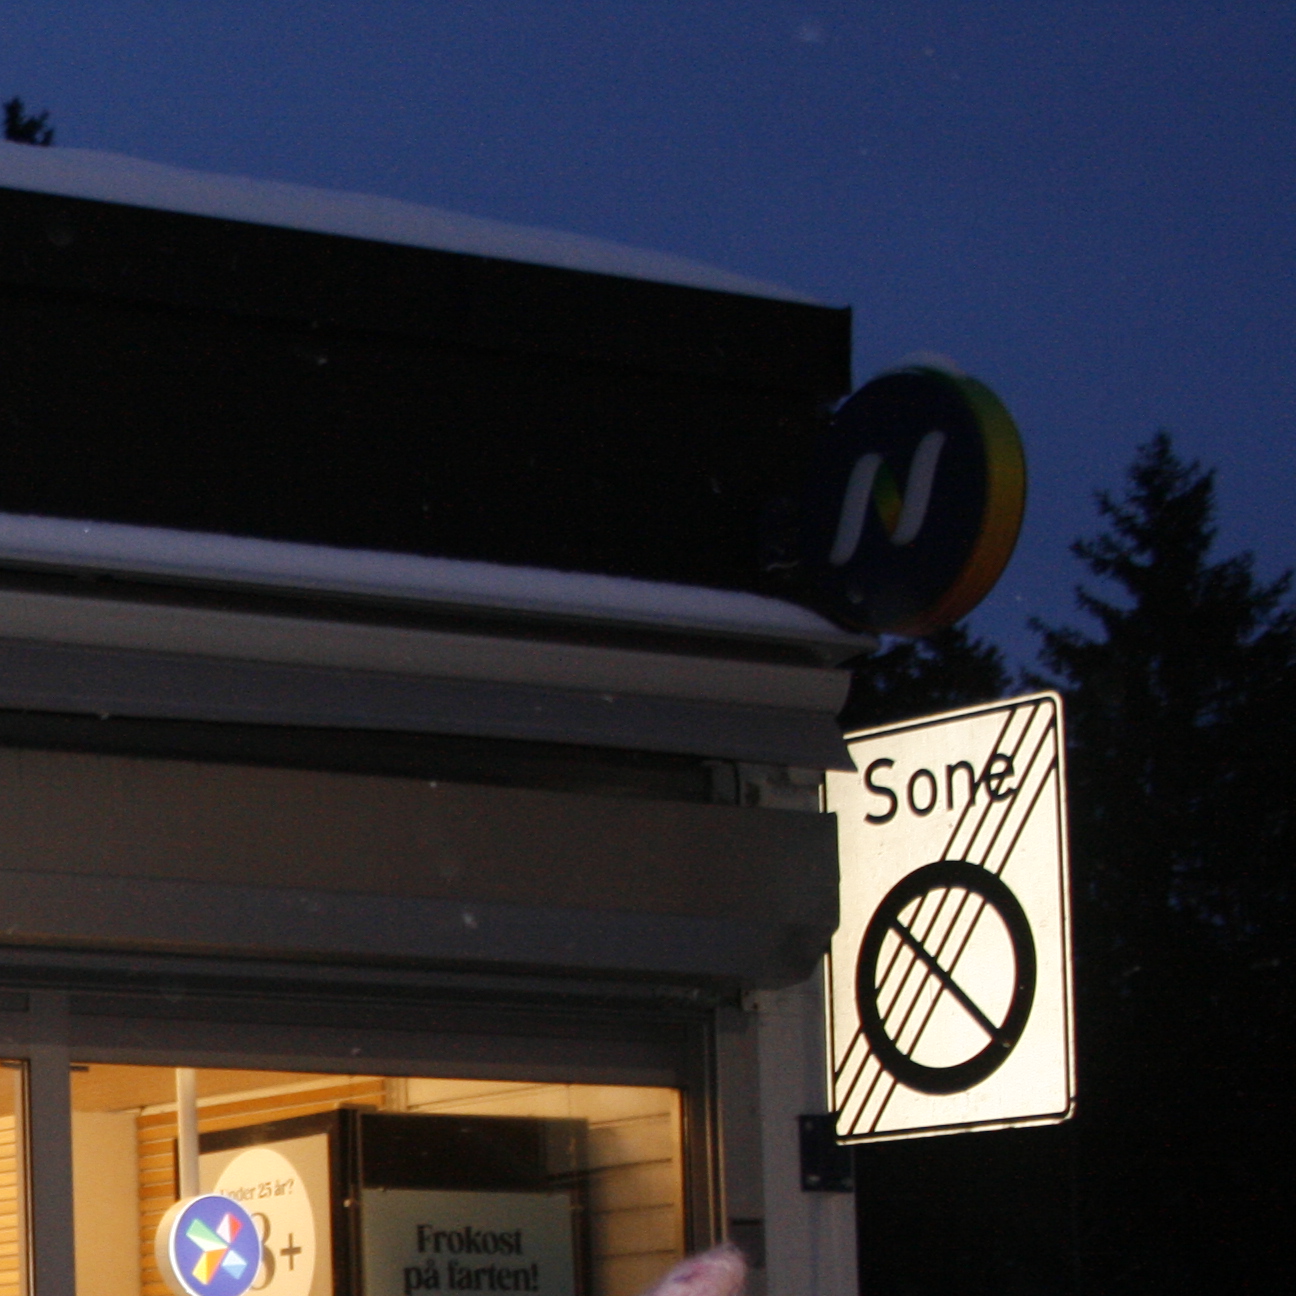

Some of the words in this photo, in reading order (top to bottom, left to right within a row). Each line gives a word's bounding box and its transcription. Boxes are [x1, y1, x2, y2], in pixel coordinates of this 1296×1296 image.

[864, 748, 1017, 826] Sone
[258, 1182, 272, 1198] 25
[416, 1223, 523, 1256] Frokost
[403, 1258, 440, 1296] på
[447, 1259, 539, 1292] farten!
